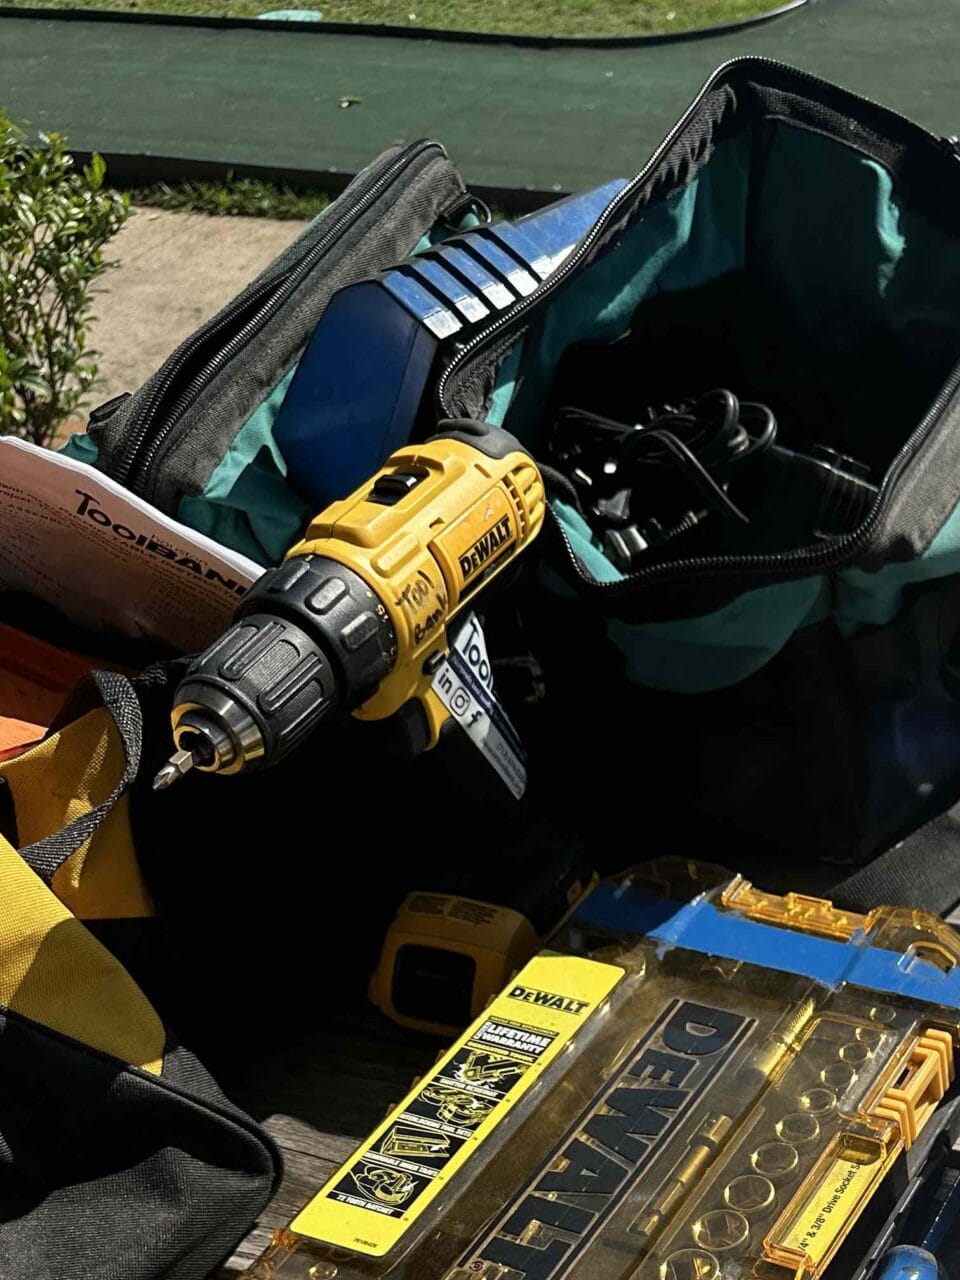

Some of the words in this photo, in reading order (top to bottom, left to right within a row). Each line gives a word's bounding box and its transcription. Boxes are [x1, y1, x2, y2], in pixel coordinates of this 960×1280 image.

[481, 1031, 545, 1055] WARRANTY
[487, 1022, 552, 1046] LIFETIME
[797, 1238, 810, 1252] /4"
[822, 1195, 842, 1214] Drive
[834, 1170, 857, 1195] Socket
